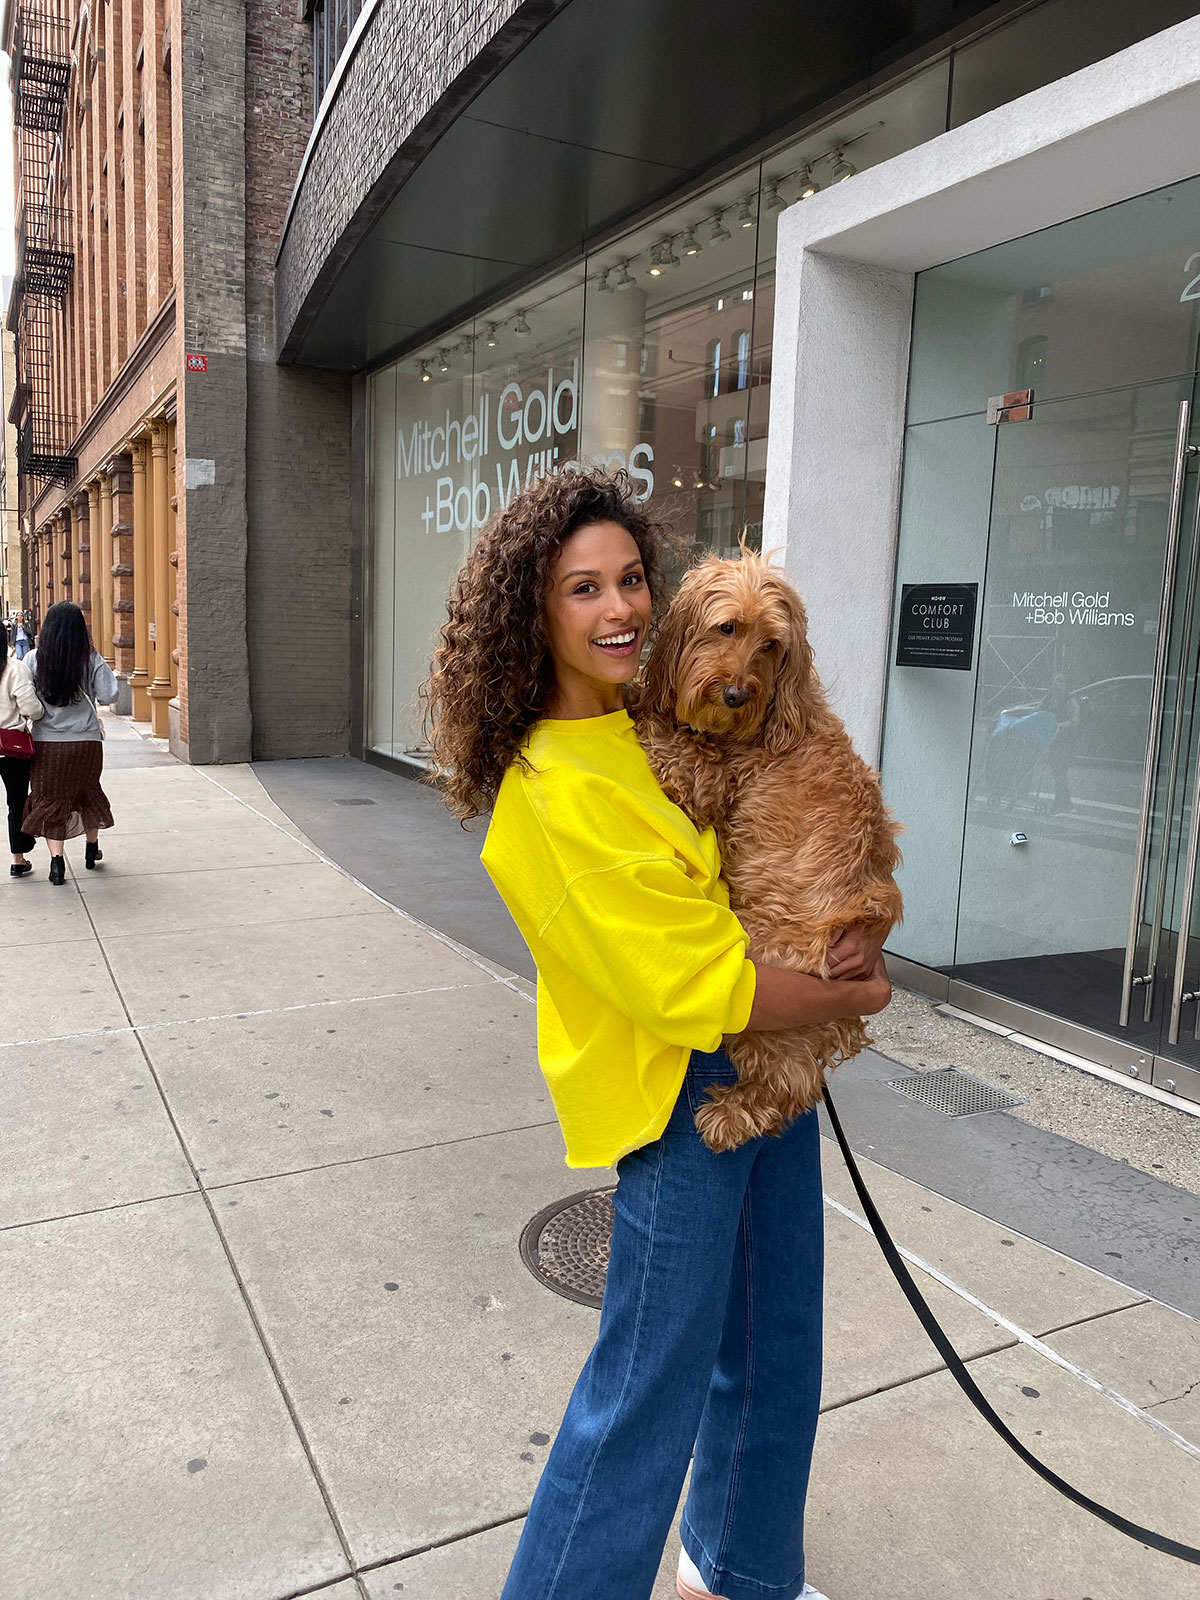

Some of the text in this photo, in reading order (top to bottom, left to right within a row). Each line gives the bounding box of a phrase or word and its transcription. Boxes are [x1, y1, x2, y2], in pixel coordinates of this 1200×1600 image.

[398, 356, 579, 480] Mitchell Gold
[421, 469, 491, 534] +Bob
[1012, 591, 1110, 608] Mitchell Gold
[911, 604, 964, 615] COMFORT
[1025, 608, 1135, 626] +Bob Williams
[922, 617, 950, 629] CLUB
